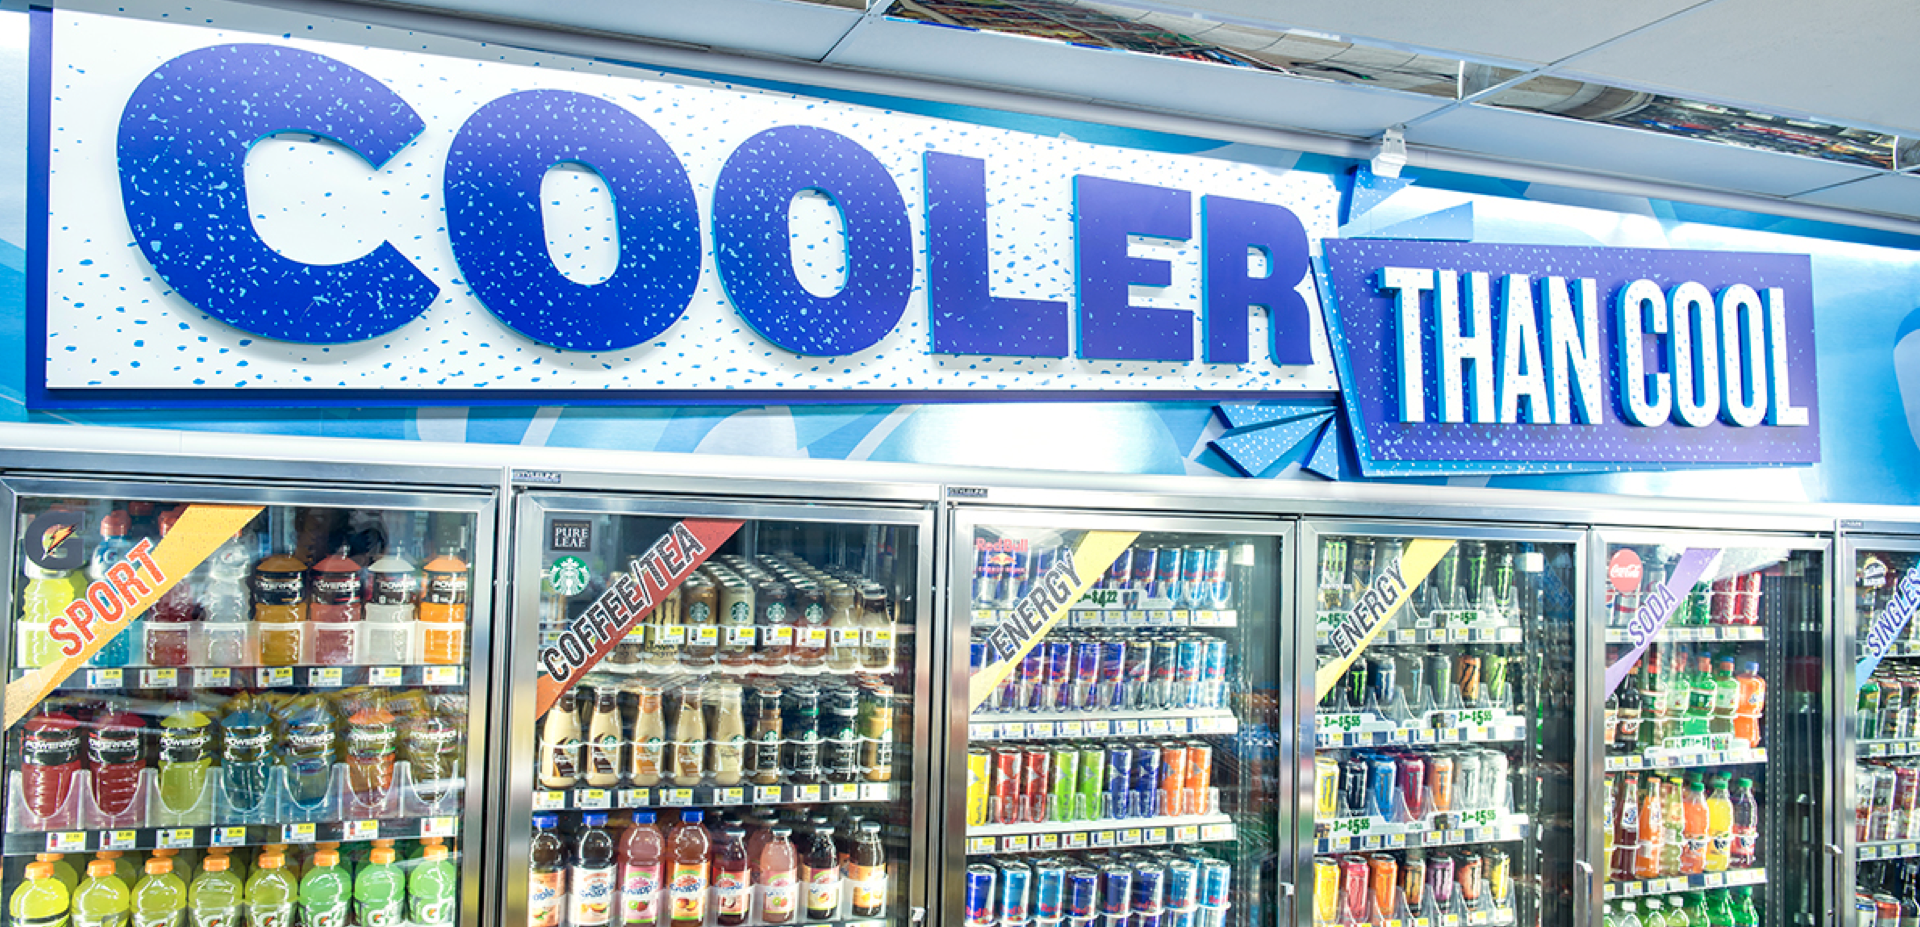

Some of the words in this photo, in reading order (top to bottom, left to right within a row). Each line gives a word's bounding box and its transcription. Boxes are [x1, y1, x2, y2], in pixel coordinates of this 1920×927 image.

[116, 43, 1314, 365] COOLER
[1378, 266, 1601, 425] THAN
[1619, 279, 1808, 428] COOL
[554, 527, 589, 538] PURE
[976, 537, 1002, 551] Red
[1004, 538, 1028, 552] Bull
[49, 538, 166, 657] SPORT
[543, 522, 706, 682] COFFEE/TEA
[991, 552, 1082, 661] ENERGY
[1331, 558, 1407, 658] ENERGY
[1629, 583, 1676, 646] SODA
